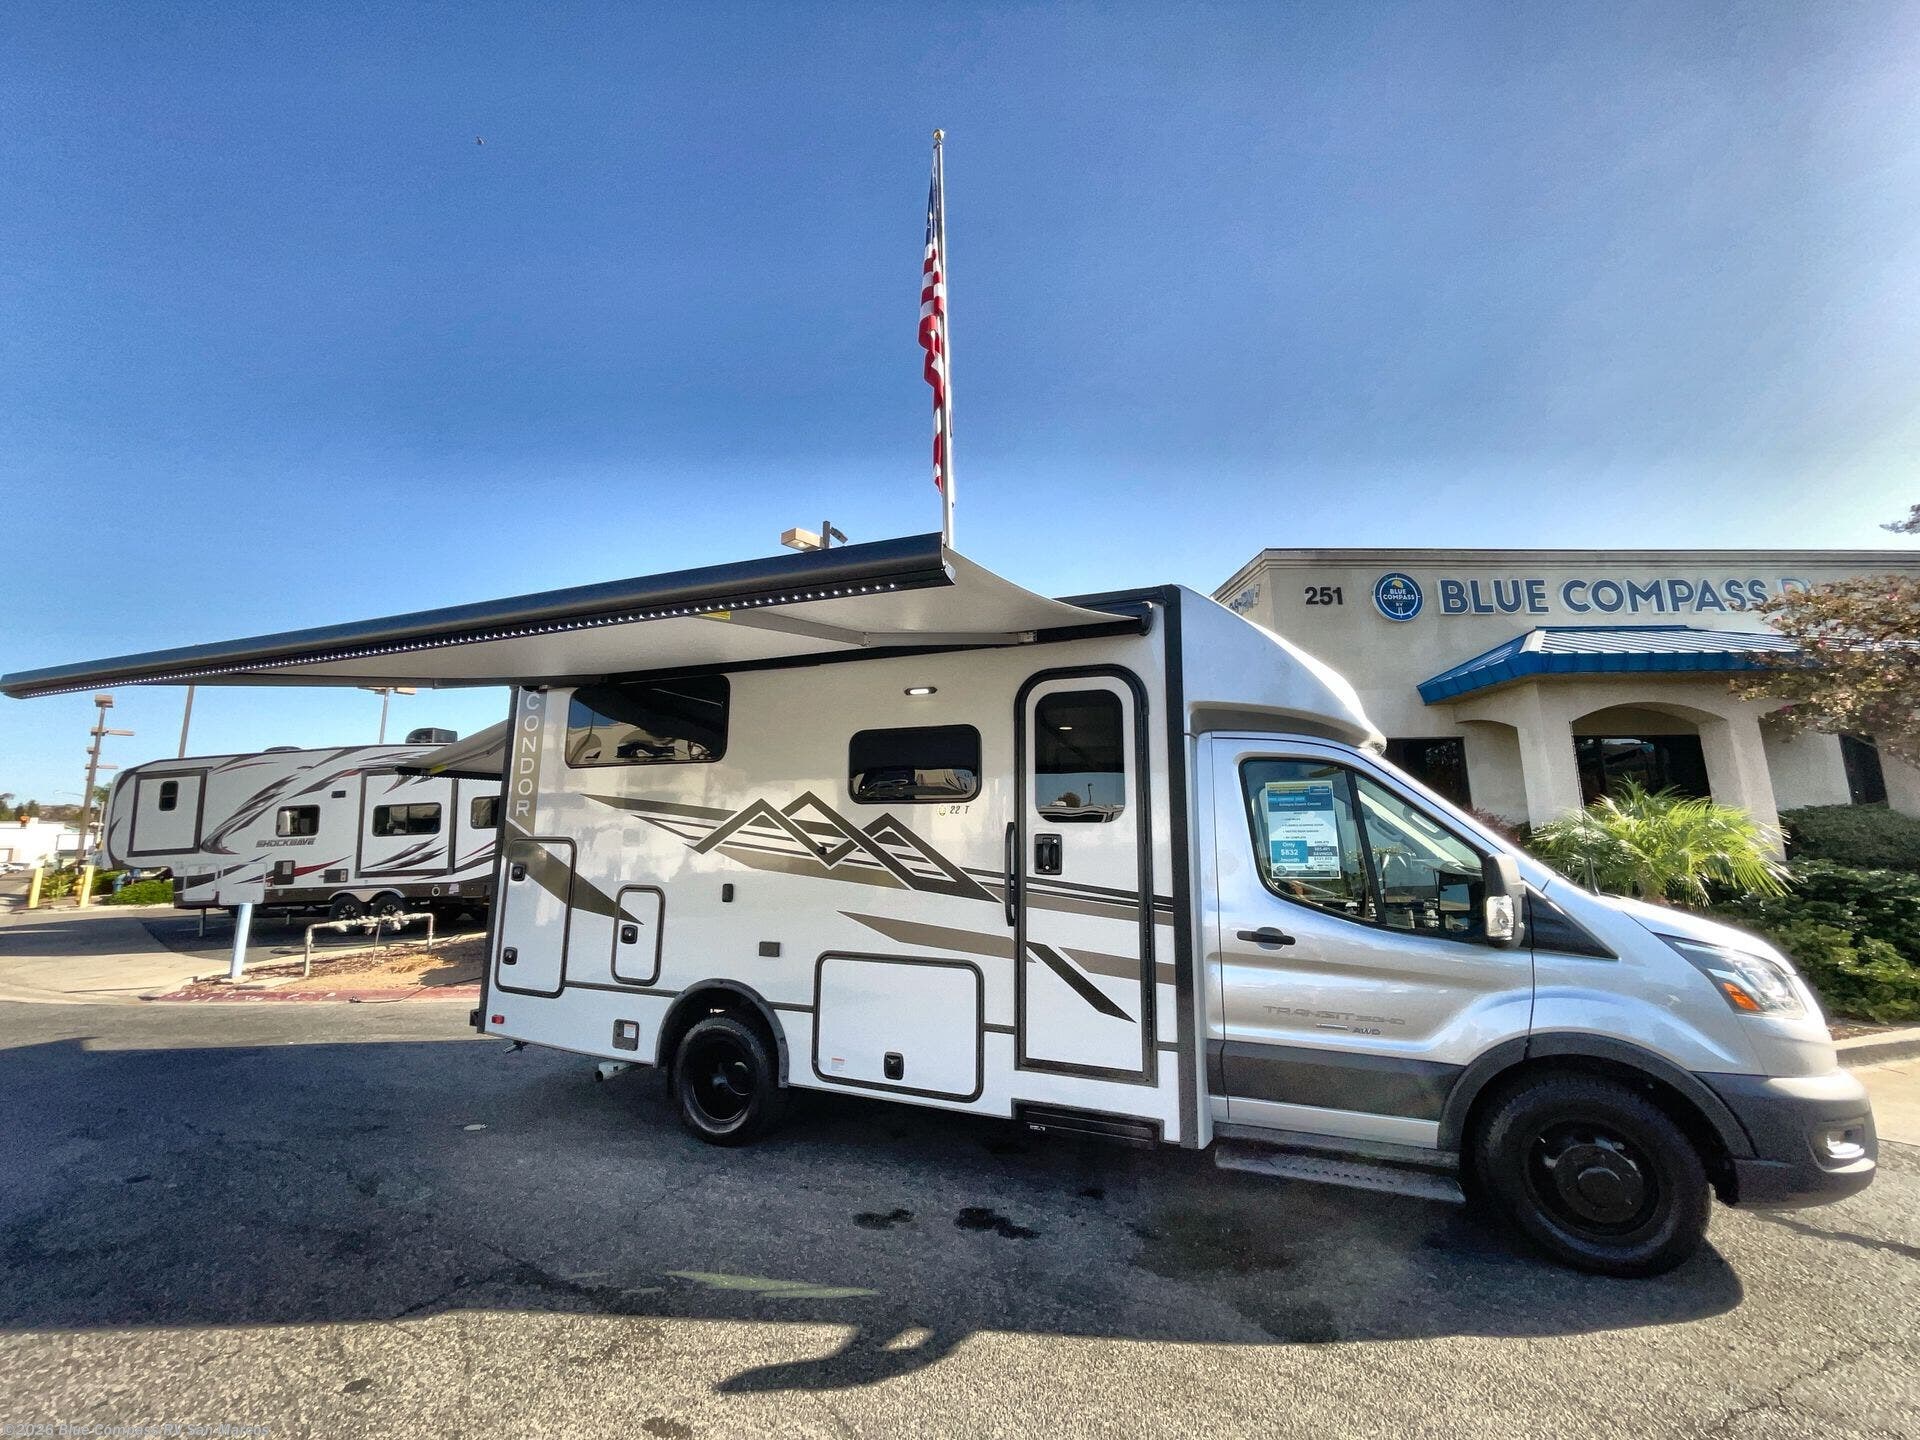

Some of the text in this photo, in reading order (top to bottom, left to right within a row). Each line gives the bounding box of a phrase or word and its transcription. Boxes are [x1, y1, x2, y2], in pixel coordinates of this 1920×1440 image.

[1304, 586, 1343, 605] 251
[1438, 579, 1549, 614] BLUE
[1560, 579, 1769, 613] COMPASS
[515, 693, 540, 817] CONDOR
[255, 837, 317, 848] SHOCKWAVE
[1262, 1005, 1354, 1022] TRANSIT
[1351, 1027, 1382, 1036] AWD
